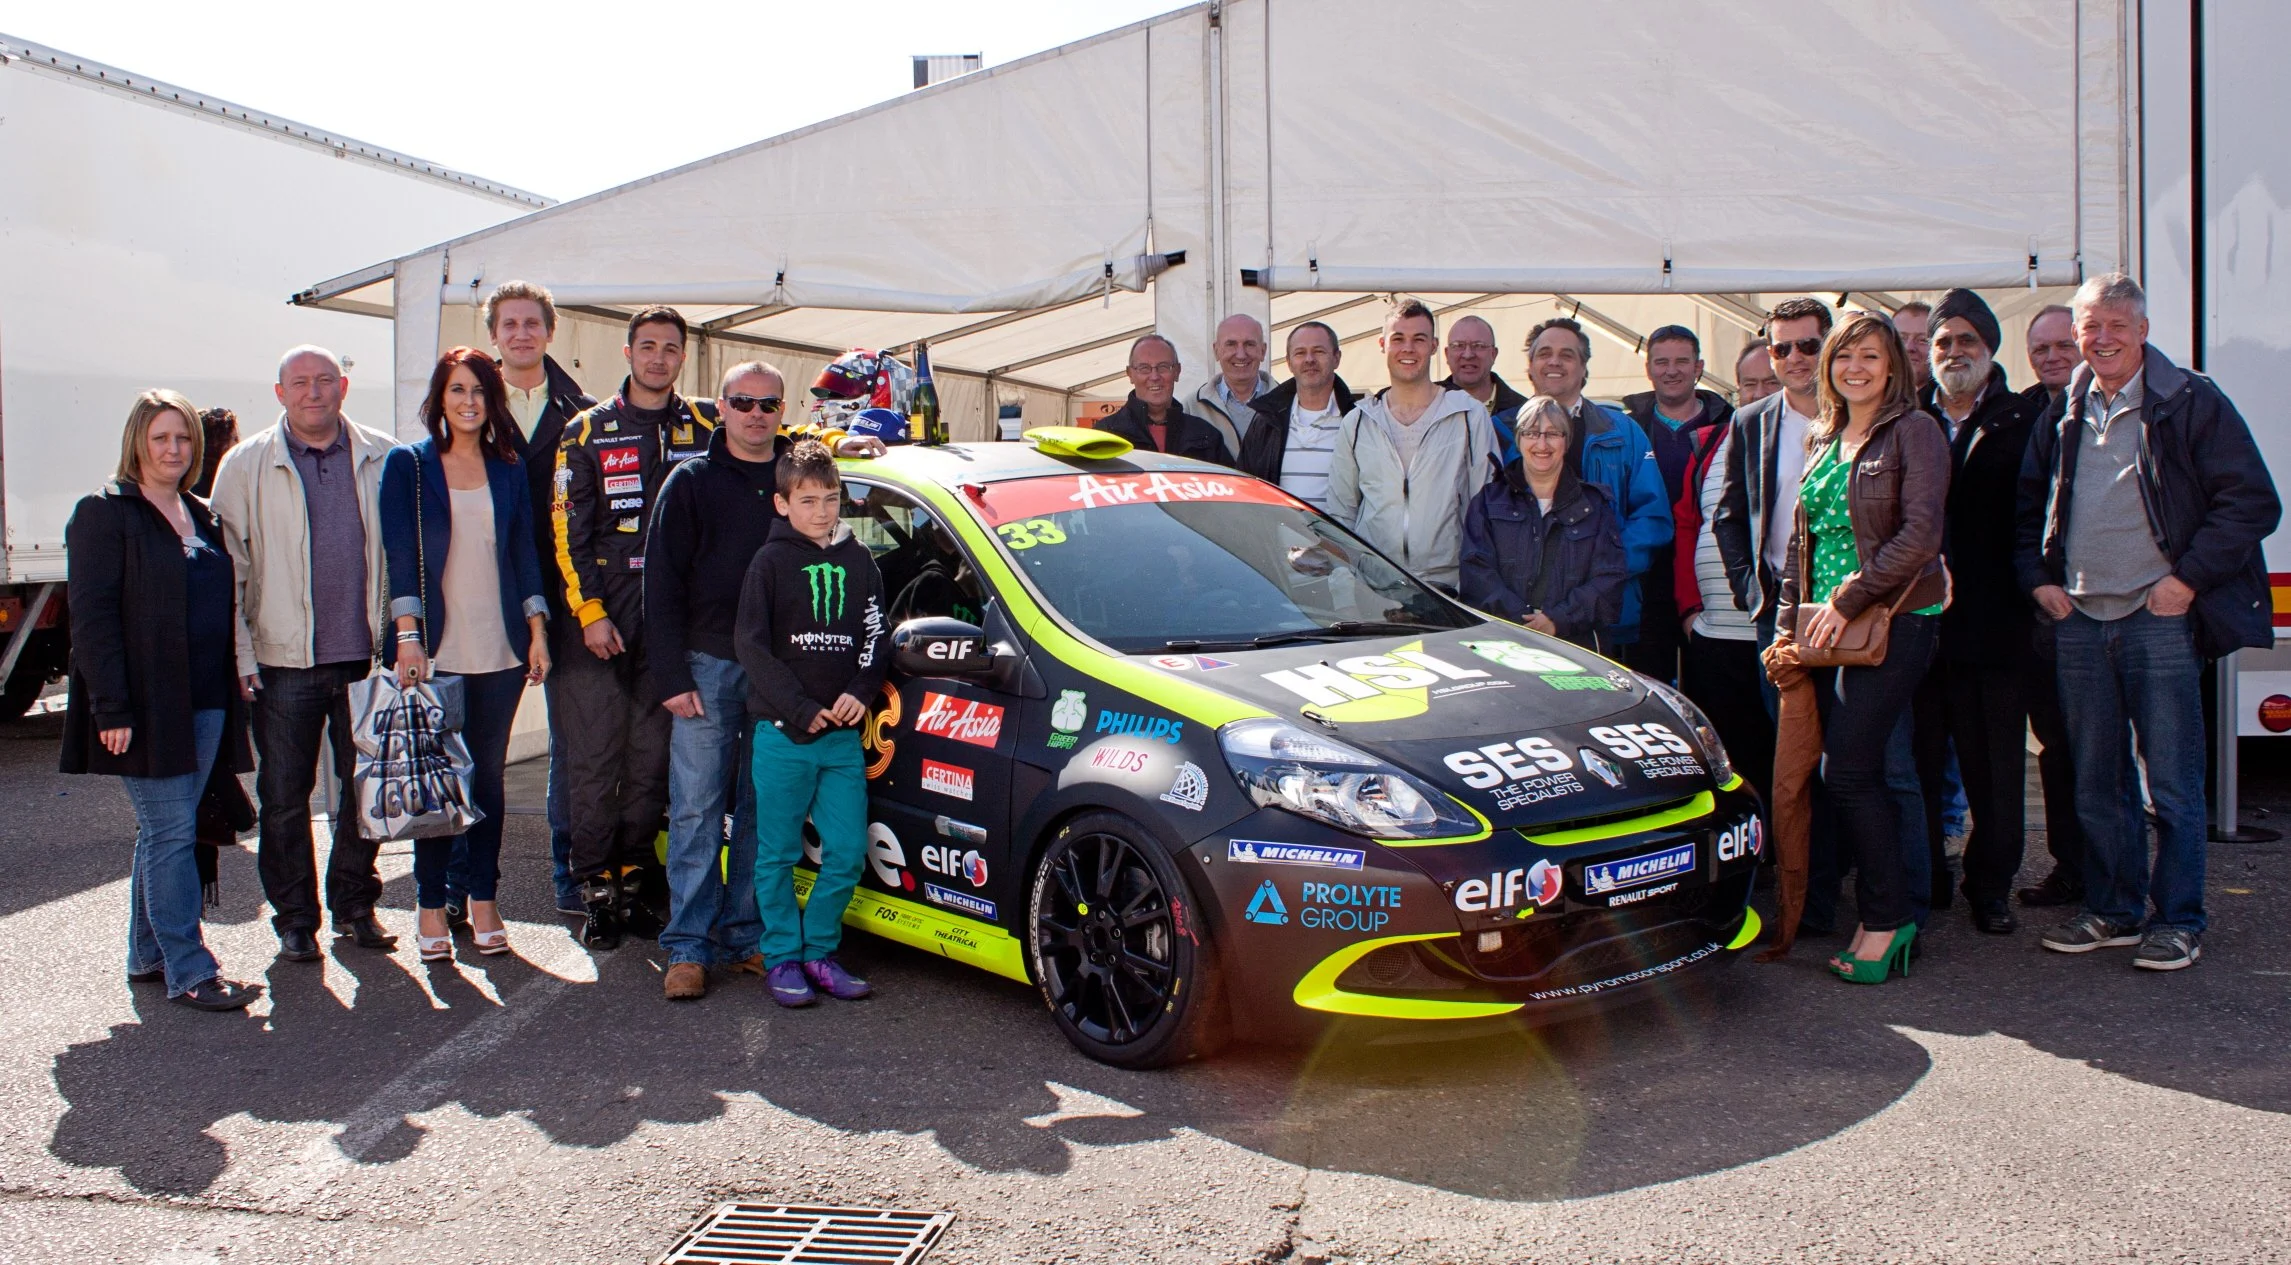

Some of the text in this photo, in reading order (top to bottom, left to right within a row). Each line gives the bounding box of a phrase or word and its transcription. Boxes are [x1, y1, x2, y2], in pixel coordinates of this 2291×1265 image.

[604, 452, 639, 470] Air Asia
[609, 478, 640, 488] CERTINA
[1069, 472, 1141, 509] Air
[1143, 473, 1235, 503] Asia
[996, 518, 1068, 551] 33
[927, 640, 974, 660] elf
[1259, 650, 1493, 709] HSL
[915, 693, 1001, 739] Air Asia
[1095, 709, 1184, 745] PHILIPS
[1049, 732, 1079, 743] GREEN
[1588, 722, 1693, 759] SES
[1091, 747, 1149, 773] WILDS
[1443, 736, 1574, 789] SES
[1634, 755, 1699, 769] THE POWER
[1643, 765, 1706, 779] SPECIALISTS
[926, 765, 973, 790] CERTINA
[1489, 772, 1577, 800] THE POWER
[1497, 782, 1585, 812] SPECIALISTS
[1717, 821, 1749, 862] elf
[921, 844, 962, 877] elf
[1260, 846, 1359, 865] MICHELIN
[1617, 850, 1691, 881] MICHELIN
[943, 891, 993, 915] MICHELIN
[1302, 881, 1402, 908] PROLYTE
[1455, 868, 1524, 913] elf
[1608, 881, 1679, 908] RENAULT SPORT
[874, 906, 899, 922] FOS
[896, 918, 921, 930] SYSTEMS
[1300, 907, 1389, 933] GROUP
[934, 929, 979, 949] THEATRICAL
[951, 926, 971, 937] CITY
